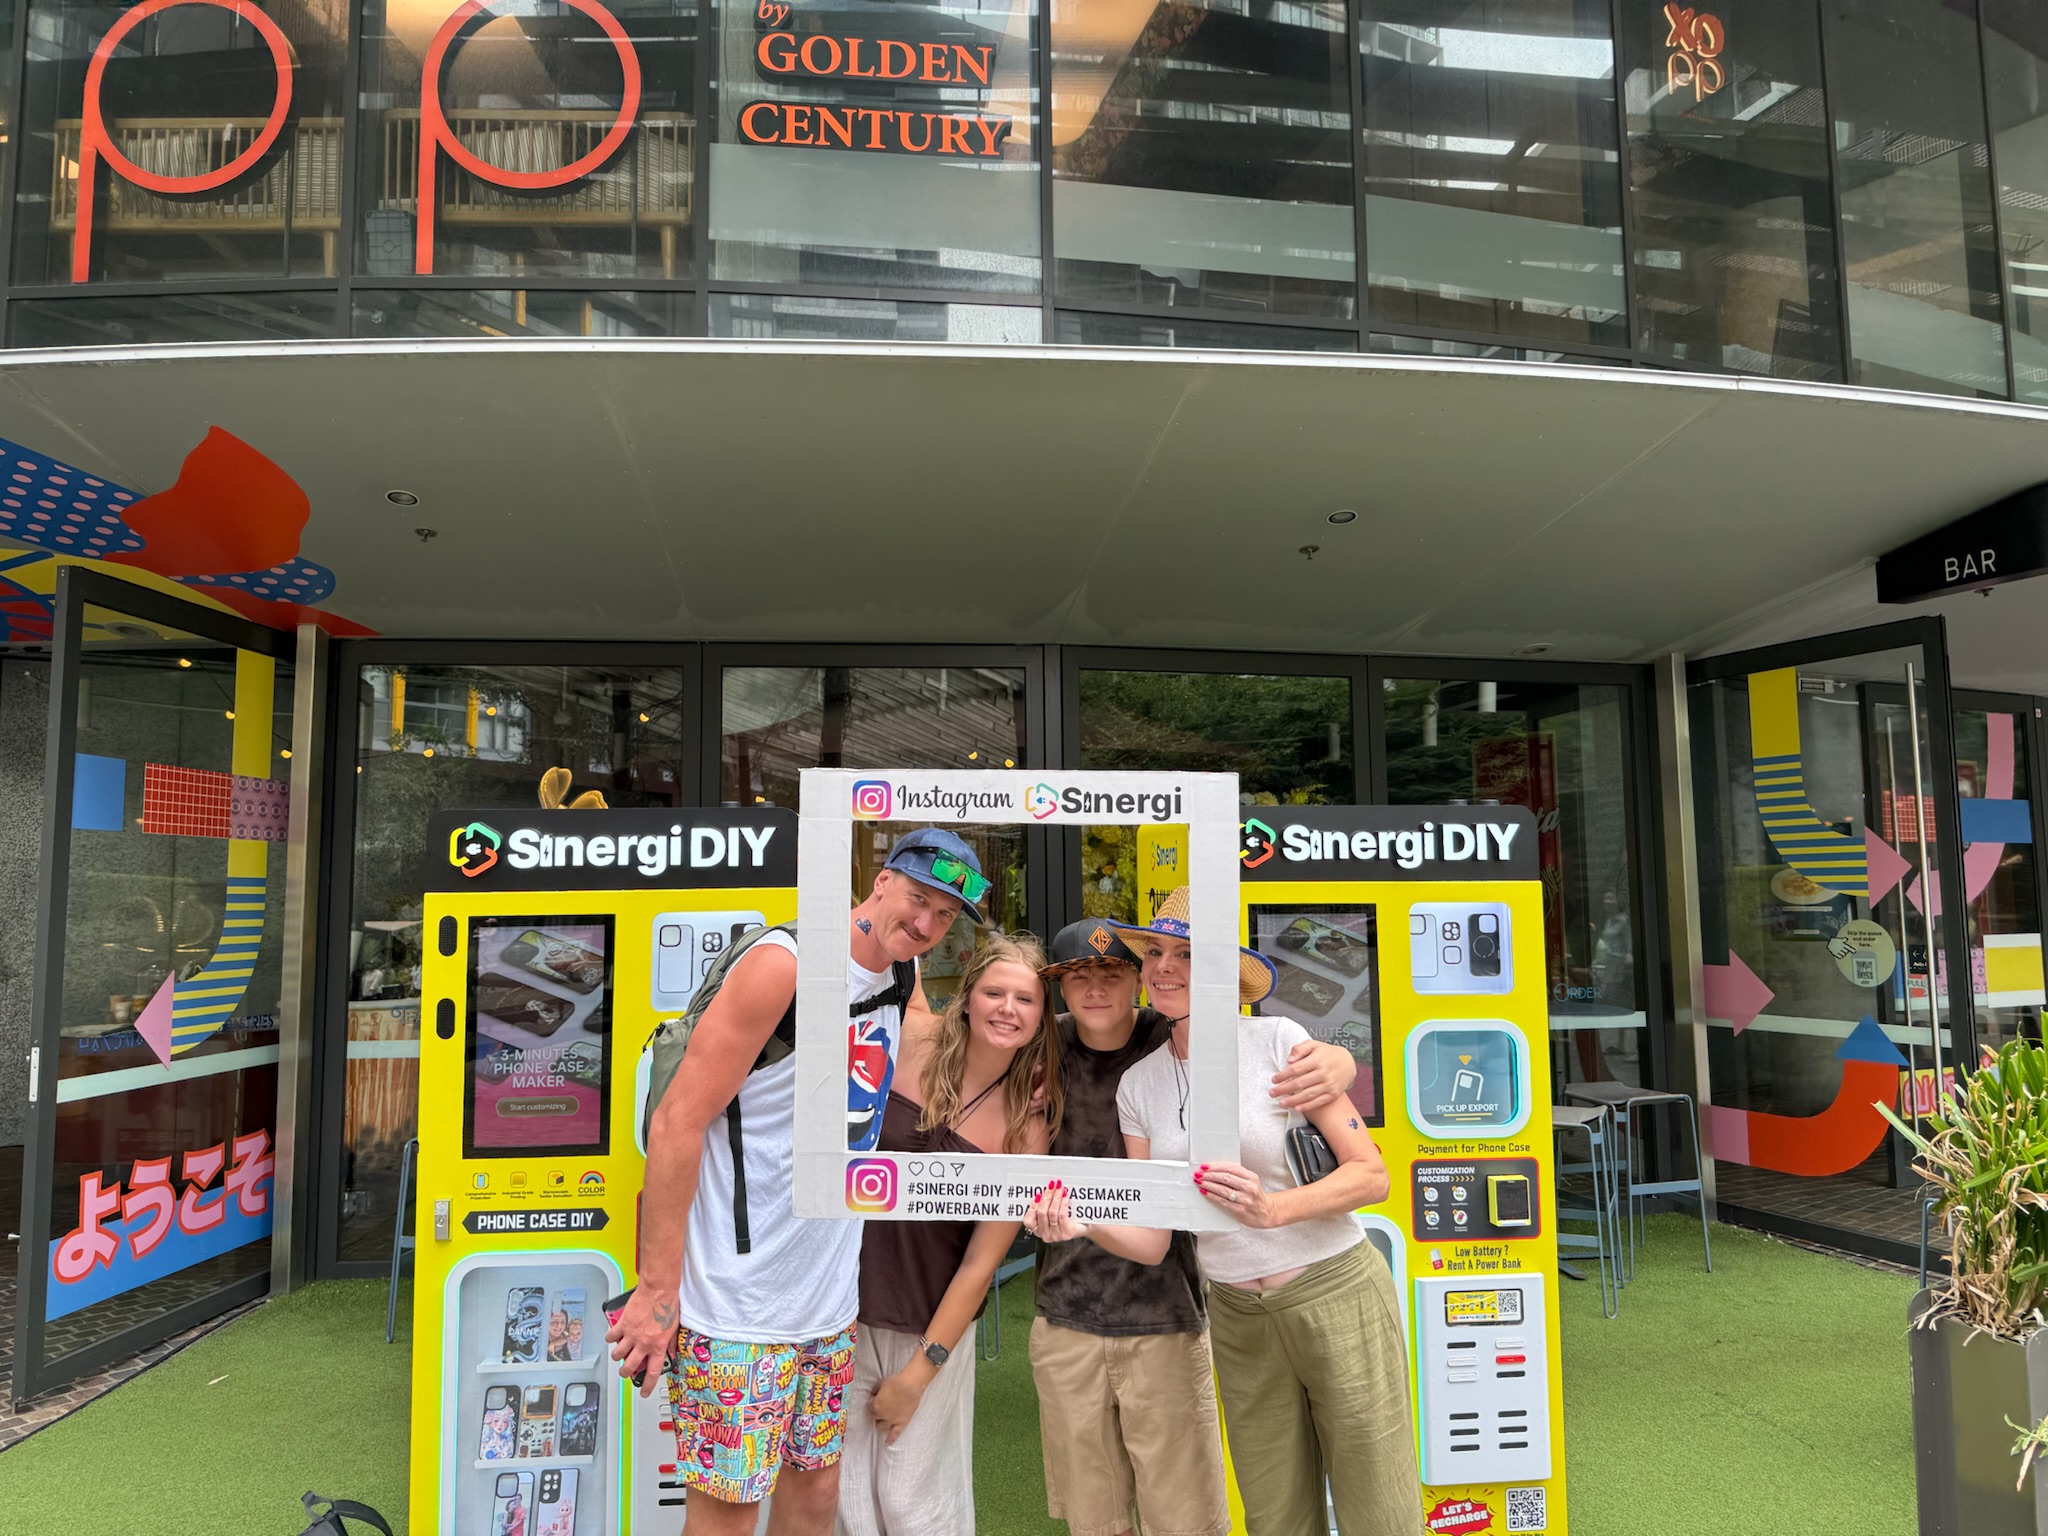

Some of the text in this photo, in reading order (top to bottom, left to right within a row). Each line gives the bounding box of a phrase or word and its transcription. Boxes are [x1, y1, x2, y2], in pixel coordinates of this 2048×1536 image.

[757, 0, 789, 26] by
[1663, 2, 1725, 58] XO
[757, 32, 992, 85] GOLDEN
[741, 103, 1008, 155] CENTURY
[1944, 549, 1997, 582] BAR
[896, 784, 1014, 819] Instagram
[1060, 786, 1183, 821] Sinergi
[507, 824, 777, 876] Sinergi DIY
[1282, 820, 1520, 870] Sinergi DIY
[1325, 1039, 1356, 1050] ASE
[500, 1048, 578, 1061] 3-MINUTES
[494, 1061, 585, 1075] PHONE CASE
[512, 1075, 565, 1088] MAKER
[526, 1103, 567, 1112] customizing
[1436, 1103, 1499, 1113] PICK UP EXPORT
[1417, 1143, 1531, 1155] Payment for Phone Case
[1417, 1167, 1475, 1175] CUSTOMIZATION
[1417, 1175, 1450, 1183] PROCESS
[578, 1186, 605, 1194] COLOR
[907, 1182, 968, 1197] #SINERGI
[972, 1184, 1002, 1198] #DIY
[53, 1128, 274, 1284] ようこそ
[907, 1201, 1000, 1217] #POWERBANK
[1076, 1206, 1128, 1220] SQUARE
[477, 1212, 594, 1230] PHONE CASE DIY
[1455, 1246, 1470, 1257] Low
[1473, 1245, 1502, 1257] Battery
[1447, 1258, 1521, 1270] Rent A Power Bank
[711, 1362, 749, 1377] BOOM!
[711, 1376, 748, 1391] BOOM!
[699, 1404, 719, 1420] OMG
[816, 1418, 830, 1433] OH
[812, 1424, 838, 1447] YEAH!
[1441, 1501, 1473, 1516] LET'S
[1430, 1510, 1488, 1529] RECHARGE
